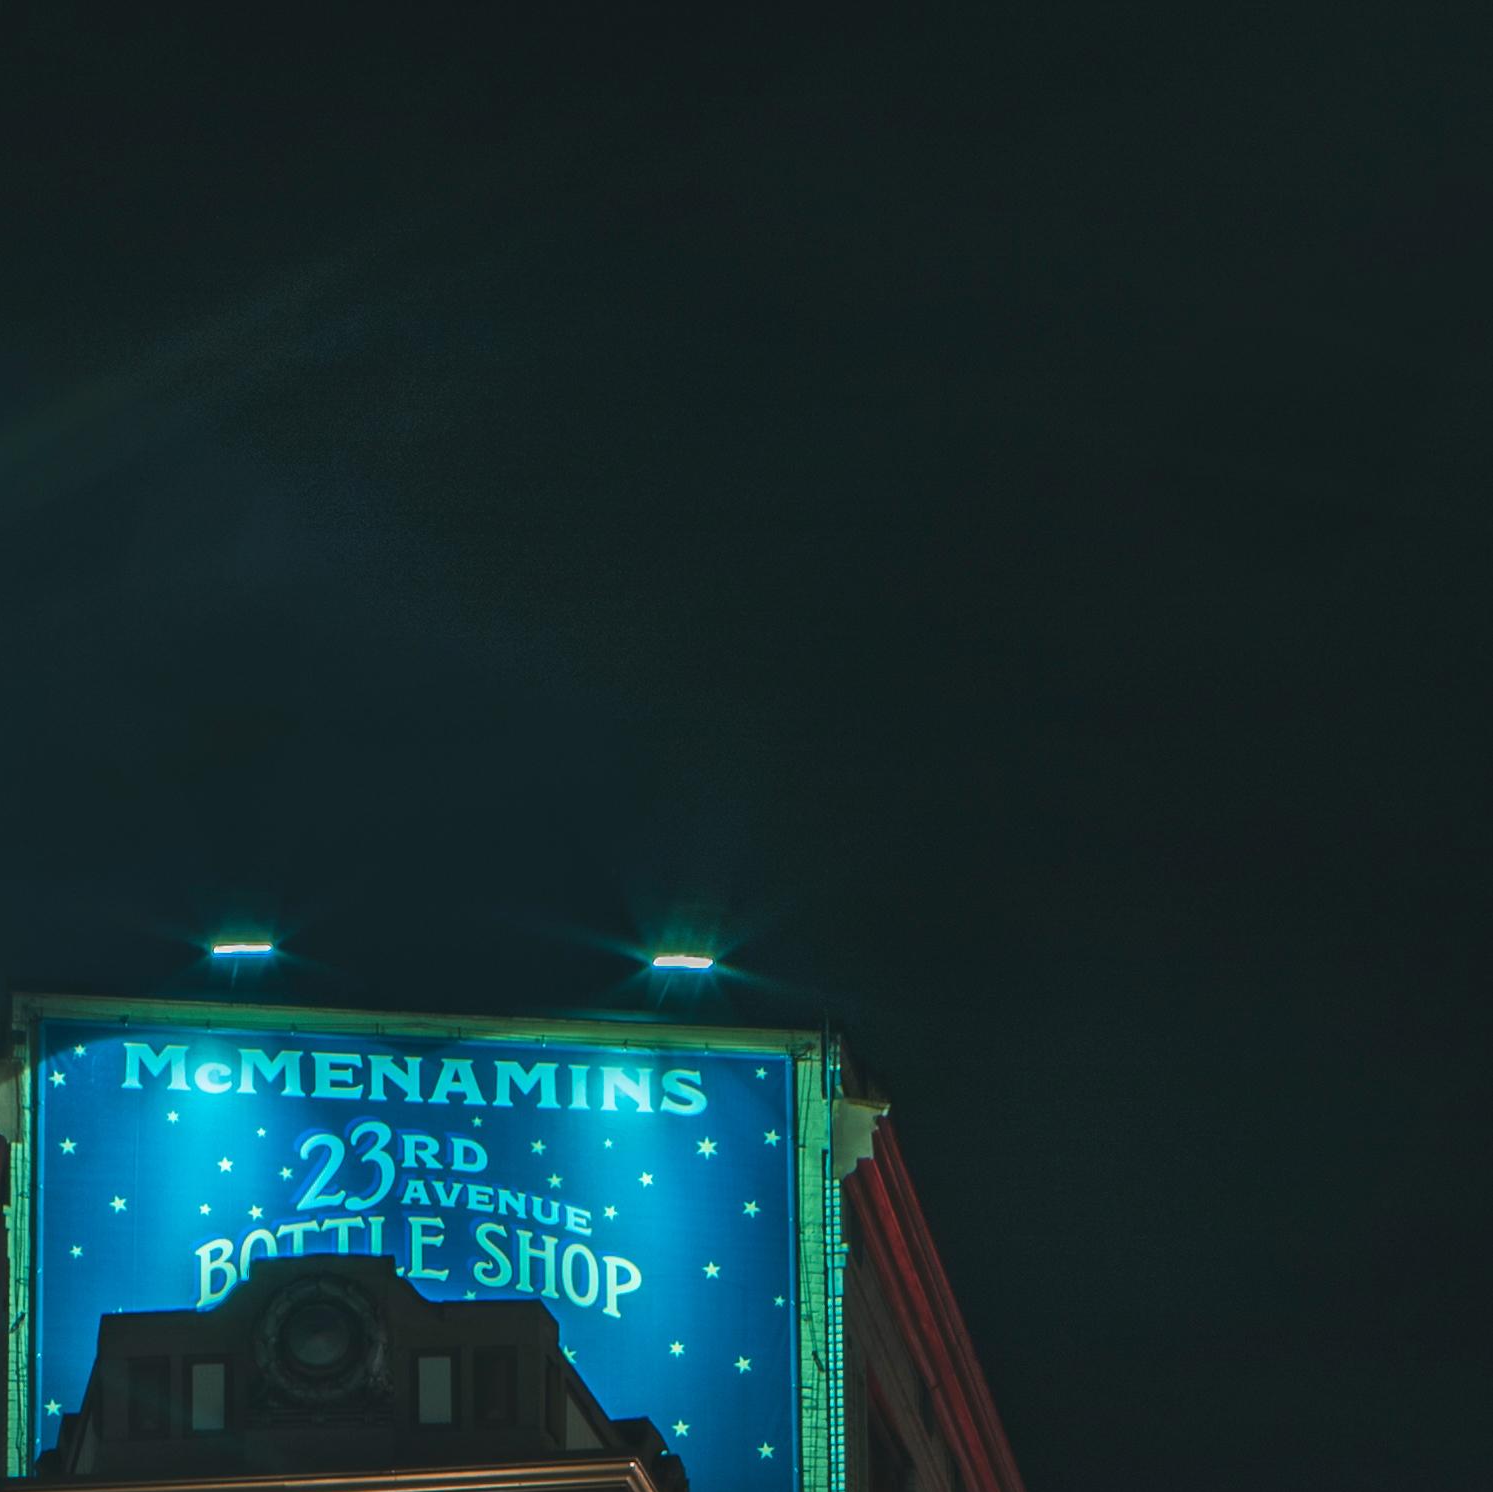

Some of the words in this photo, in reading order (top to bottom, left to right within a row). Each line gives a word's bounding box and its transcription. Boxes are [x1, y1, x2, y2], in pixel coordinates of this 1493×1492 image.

[123, 1042, 708, 1117] McMENAMINS
[401, 1180, 593, 1238] AVENUE
[472, 1225, 643, 1319] SHOP
